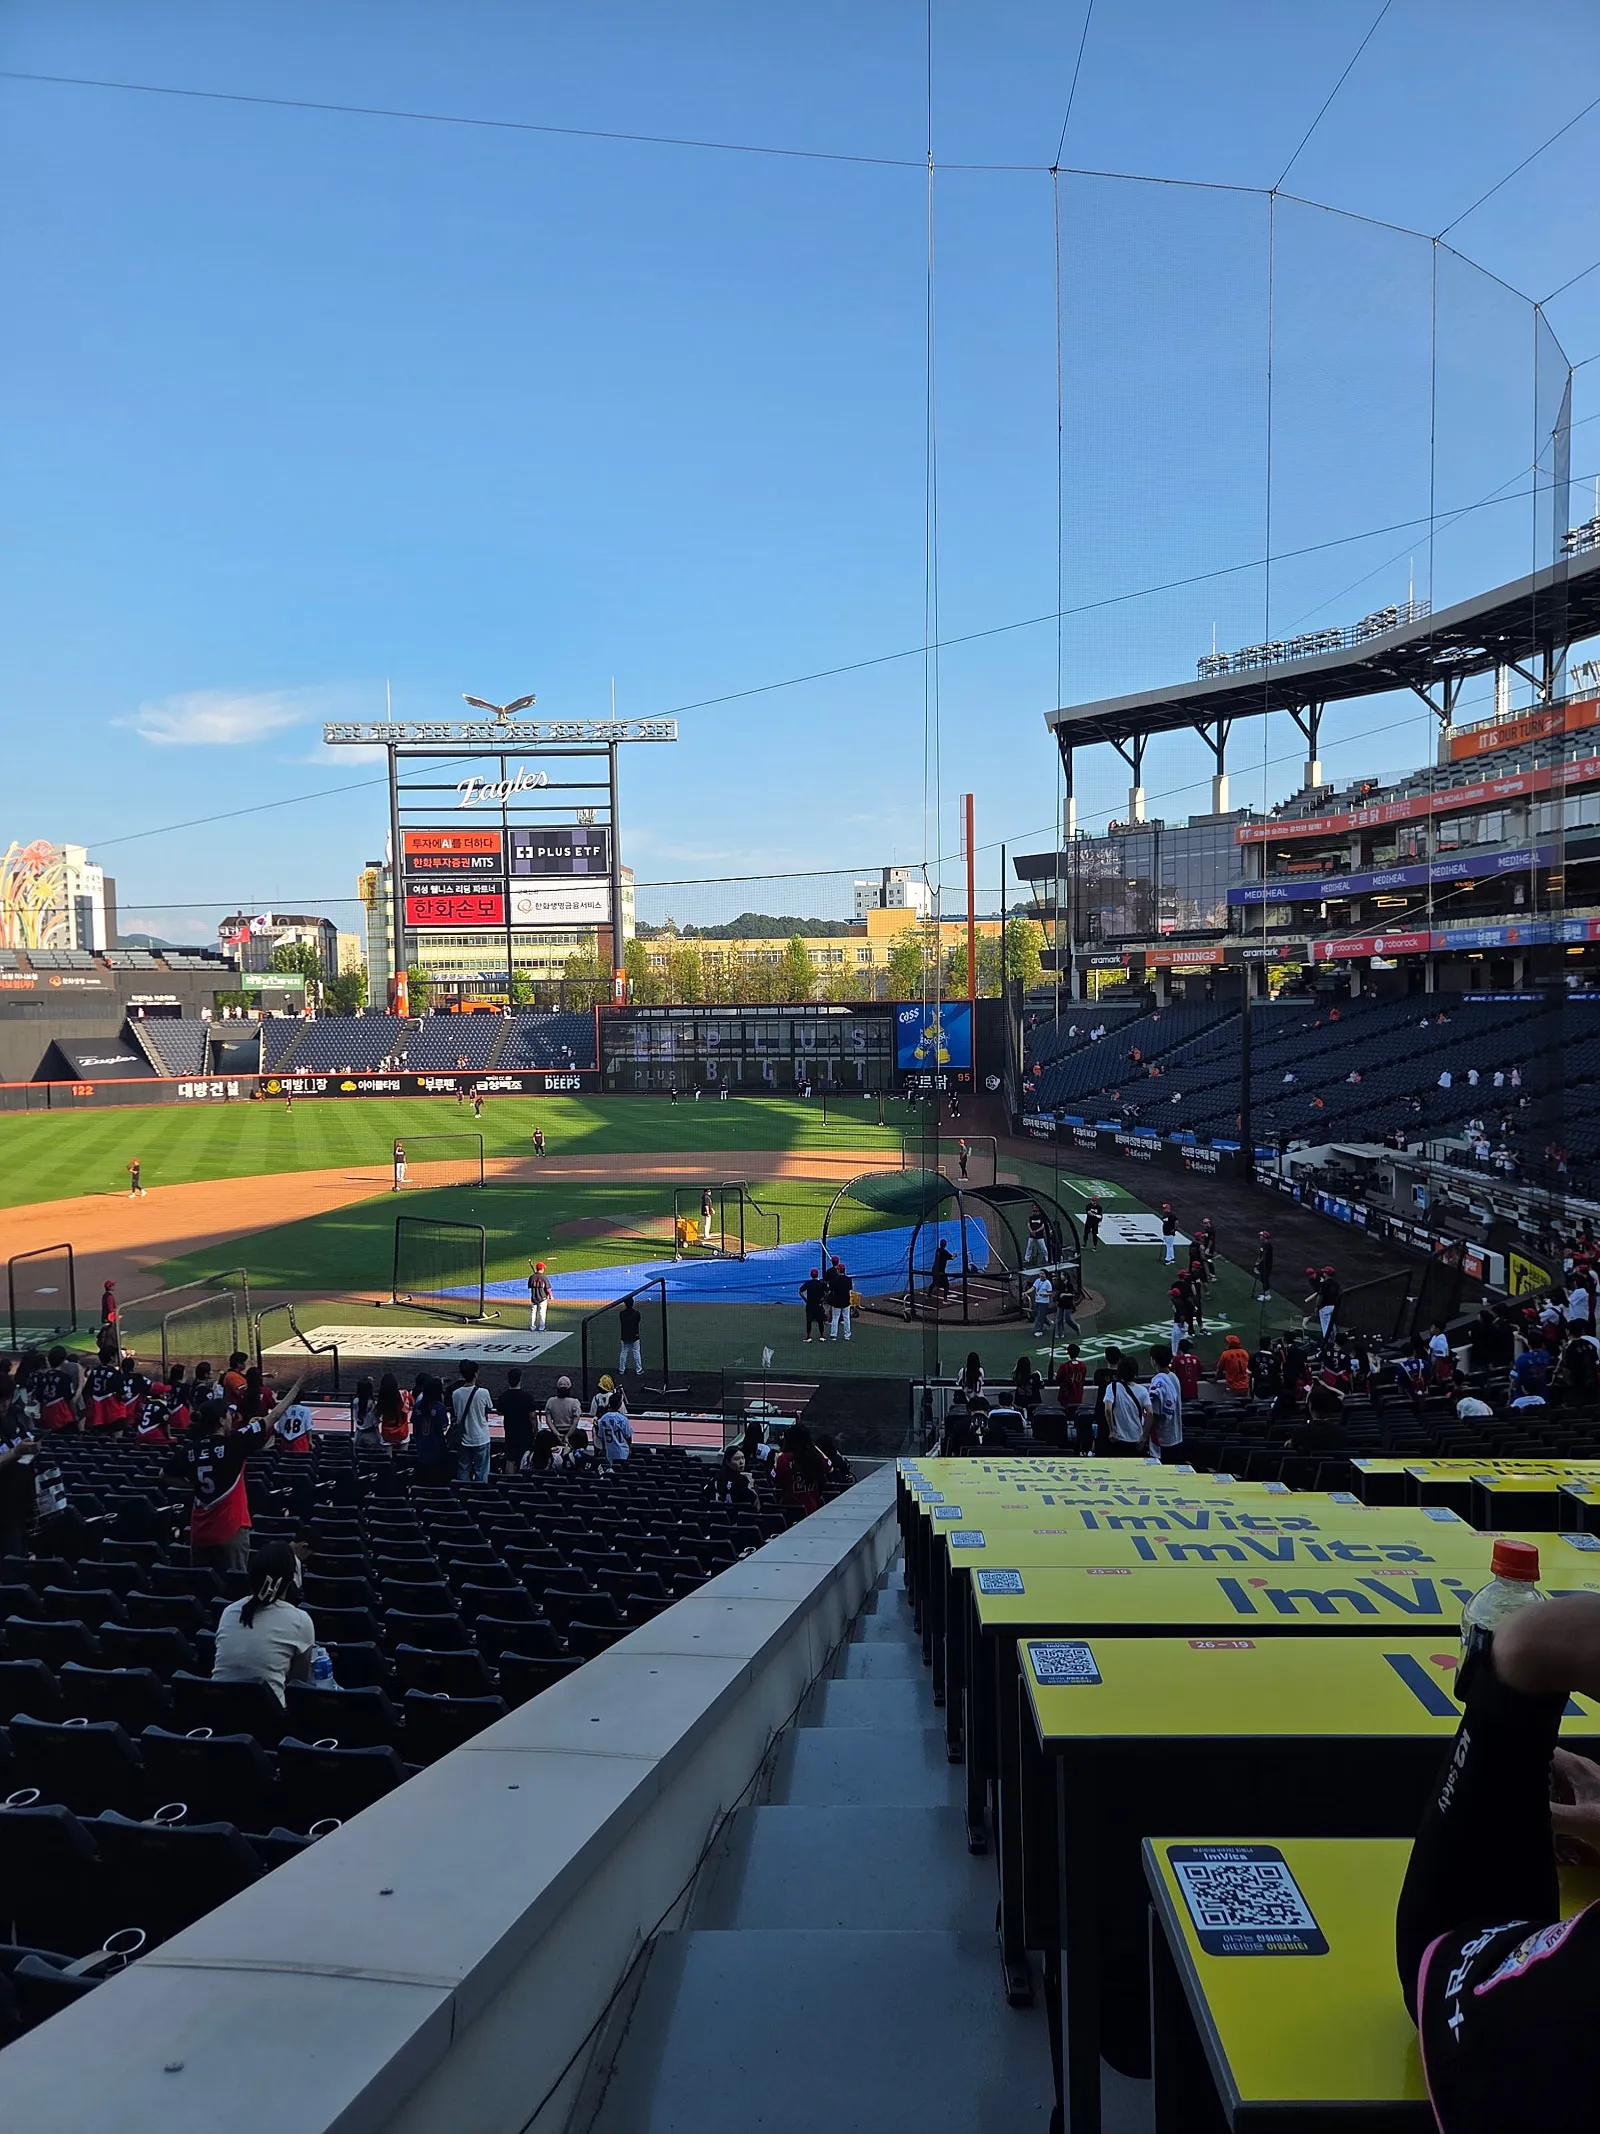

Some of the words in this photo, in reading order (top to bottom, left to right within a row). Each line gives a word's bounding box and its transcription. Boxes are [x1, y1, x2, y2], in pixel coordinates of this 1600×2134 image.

[1478, 734, 1489, 749] IT
[1489, 732, 1499, 747] IS
[1500, 727, 1518, 743] OUR
[1520, 719, 1545, 738] TURN
[456, 765, 549, 808] Eagles
[412, 838, 462, 849] 투자에AI를
[464, 838, 493, 849] 더하다
[538, 847, 571, 857] PLUS
[575, 846, 600, 856] ETF
[413, 857, 494, 868] 한화투자증권MTS
[1498, 853, 1541, 867] MEDIHEAL
[1430, 864, 1468, 877] MEDIHEAL
[1371, 873, 1407, 885] MEDIHEAL
[413, 885, 428, 894] 여성
[455, 885, 471, 894] 리딩
[472, 885, 496, 894] 파트너
[1244, 887, 1288, 899] MEDIHEAL
[1320, 881, 1350, 893] MEDIHEAL
[414, 899, 497, 919] 한화손보
[1333, 943, 1364, 952] roborock
[1384, 938, 1418, 948] roborock
[1172, 951, 1217, 962] INNINGS
[1243, 947, 1278, 958] aramark
[1090, 955, 1121, 965] aramark
[899, 1008, 920, 1023] Cass
[79, 1055, 138, 1067] Eagles
[635, 1070, 676, 1080] PLUS
[957, 1073, 971, 1082] 95
[178, 1081, 239, 1098] 대방건설
[476, 1079, 523, 1091] 금성백조
[544, 1078, 581, 1090] DEEPS
[72, 1085, 95, 1097] 122
[141, 1411, 151, 1426] 5
[284, 1418, 302, 1434] 48
[197, 1465, 216, 1494] 5
[1453, 1728, 1472, 1769] K2
[1203, 1852, 1248, 1861] ImVita
